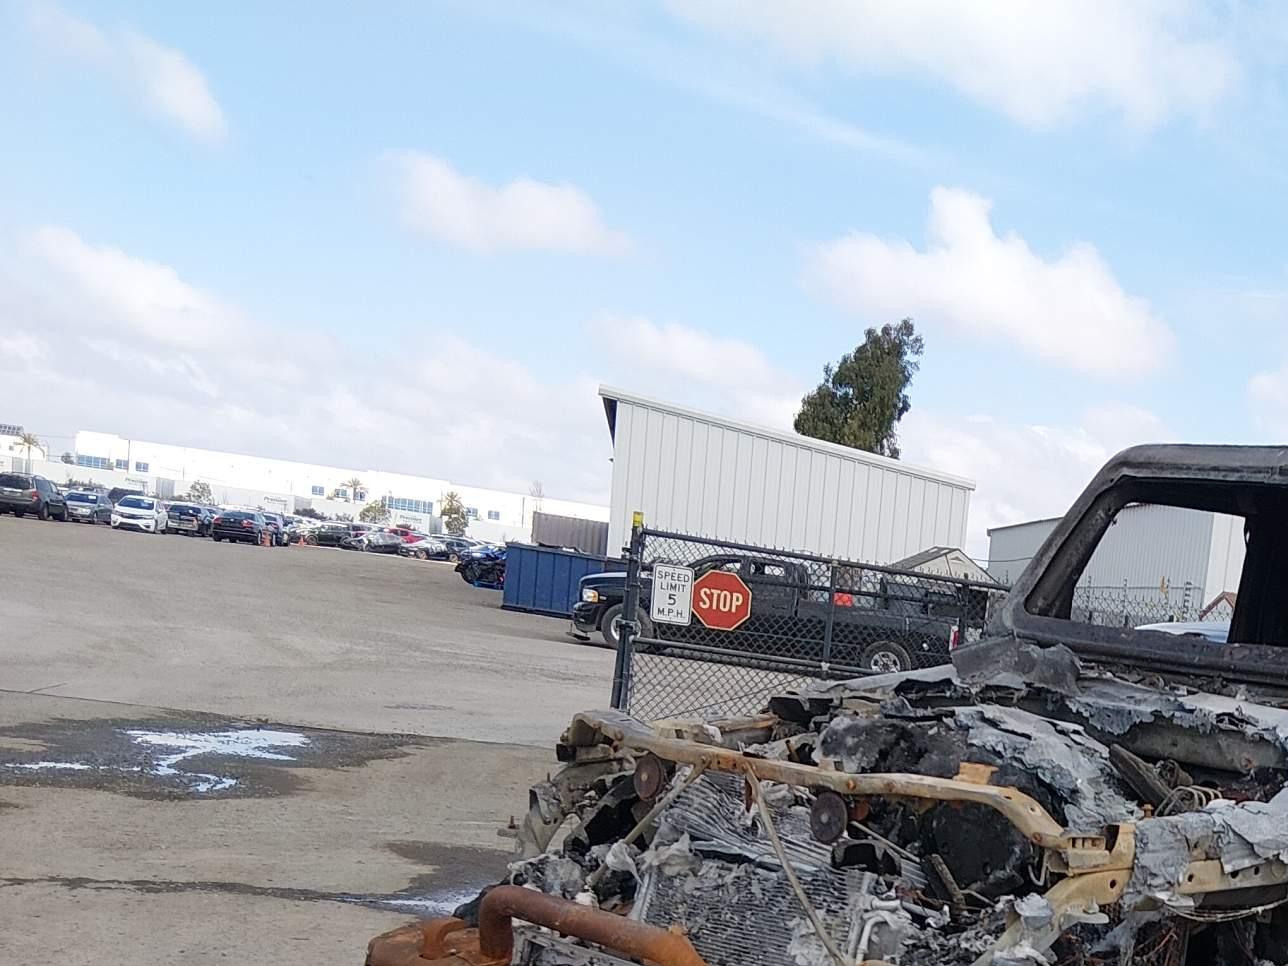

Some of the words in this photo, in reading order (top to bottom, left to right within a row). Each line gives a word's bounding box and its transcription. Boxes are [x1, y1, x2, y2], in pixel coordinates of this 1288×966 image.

[657, 570, 690, 583] SPEED
[660, 582, 686, 592] LIMIT
[667, 593, 677, 606] 5
[699, 587, 744, 613] STOP
[657, 607, 687, 619] M.P.H.
